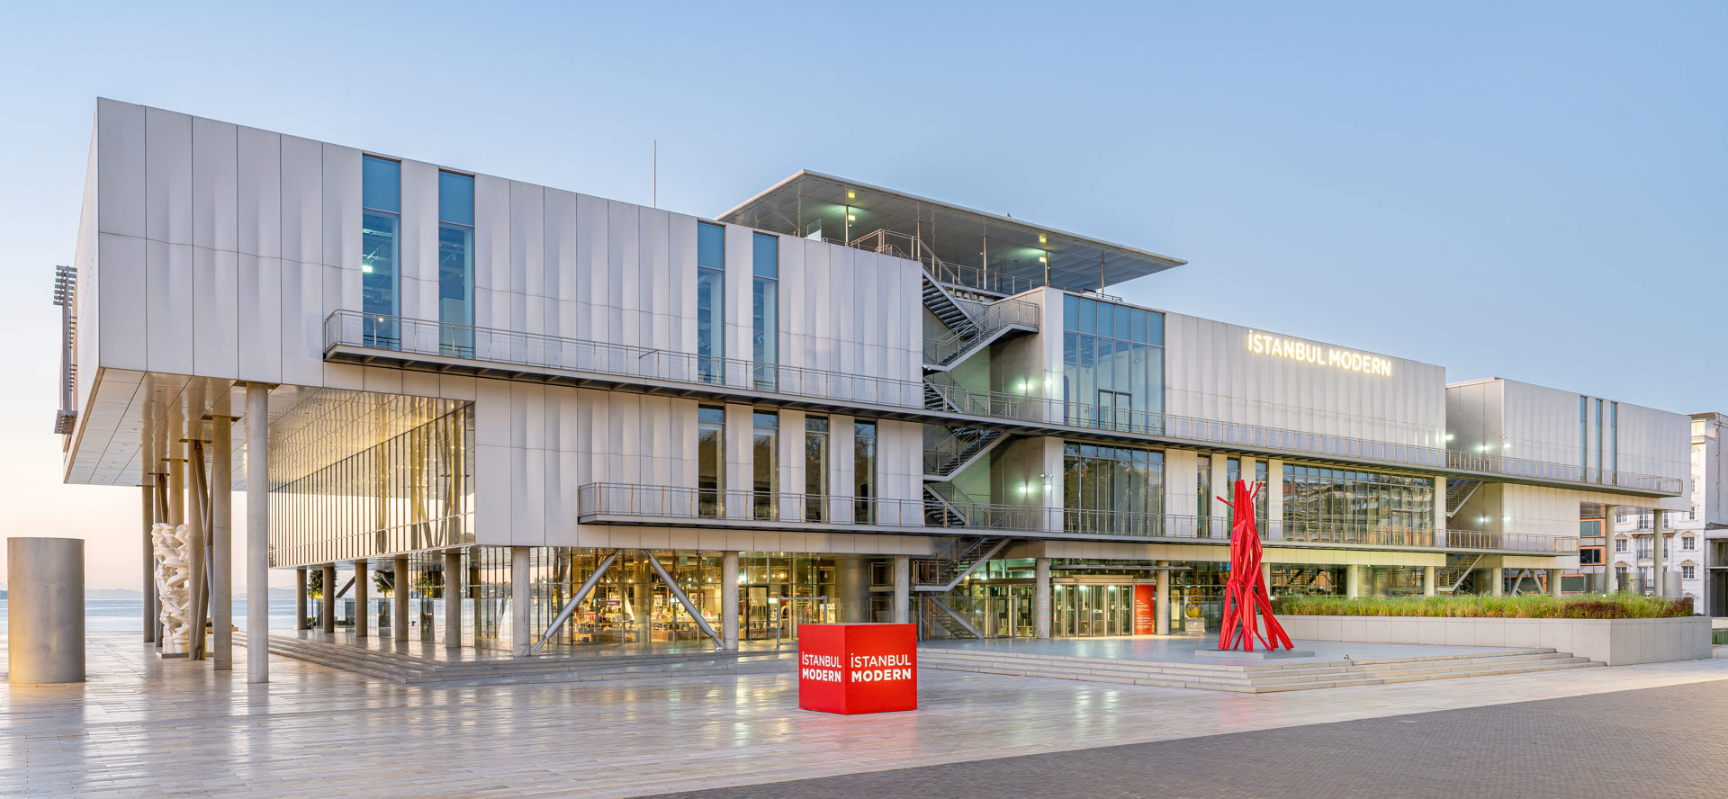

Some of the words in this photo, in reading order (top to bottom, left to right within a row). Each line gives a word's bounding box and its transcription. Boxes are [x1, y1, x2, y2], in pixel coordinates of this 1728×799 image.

[1248, 330, 1325, 365] İSTANBUL
[1328, 349, 1391, 376] MODERN
[802, 652, 842, 668] İSTANBUL
[850, 653, 912, 668] İSTANBUL
[802, 668, 842, 682] MODERN
[851, 668, 912, 682] MODERN
